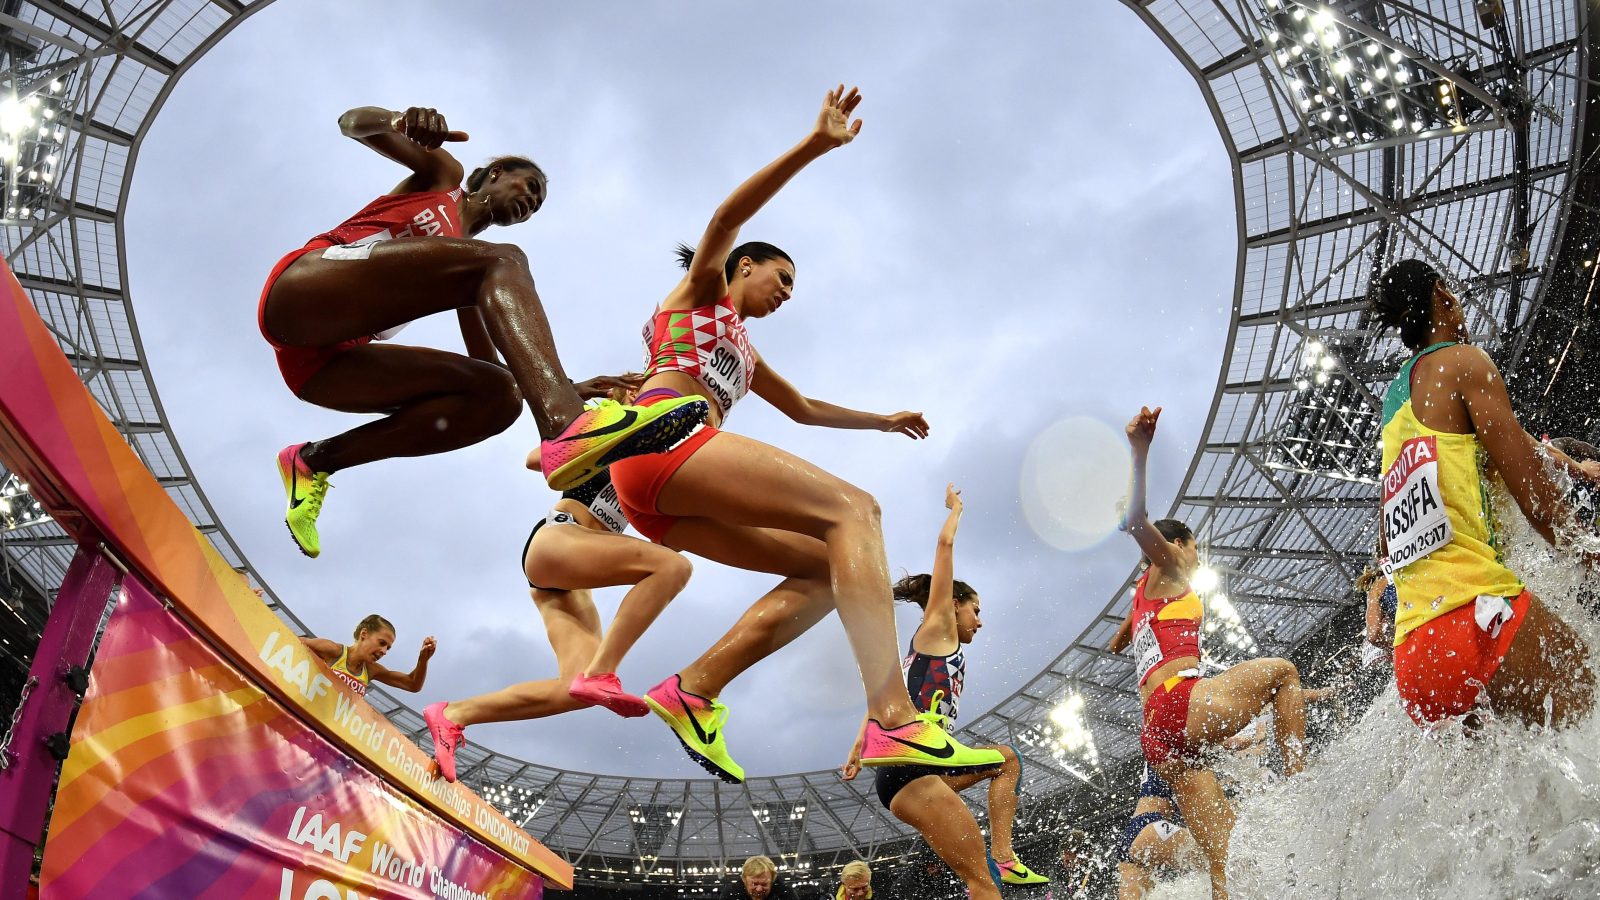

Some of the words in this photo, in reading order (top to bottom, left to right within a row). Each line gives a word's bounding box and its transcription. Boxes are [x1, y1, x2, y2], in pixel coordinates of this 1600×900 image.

[710, 346, 741, 381] SIDI
[1384, 440, 1432, 499] TOYOTA
[1385, 476, 1438, 542] ASSEFA
[259, 631, 333, 702] IAAF
[333, 692, 386, 752] World
[386, 737, 472, 818] Championships
[475, 803, 513, 847] LONDON
[513, 831, 530, 856] 2017
[287, 806, 367, 863] IAAF
[371, 841, 427, 888] World
[430, 865, 491, 900] Champi
